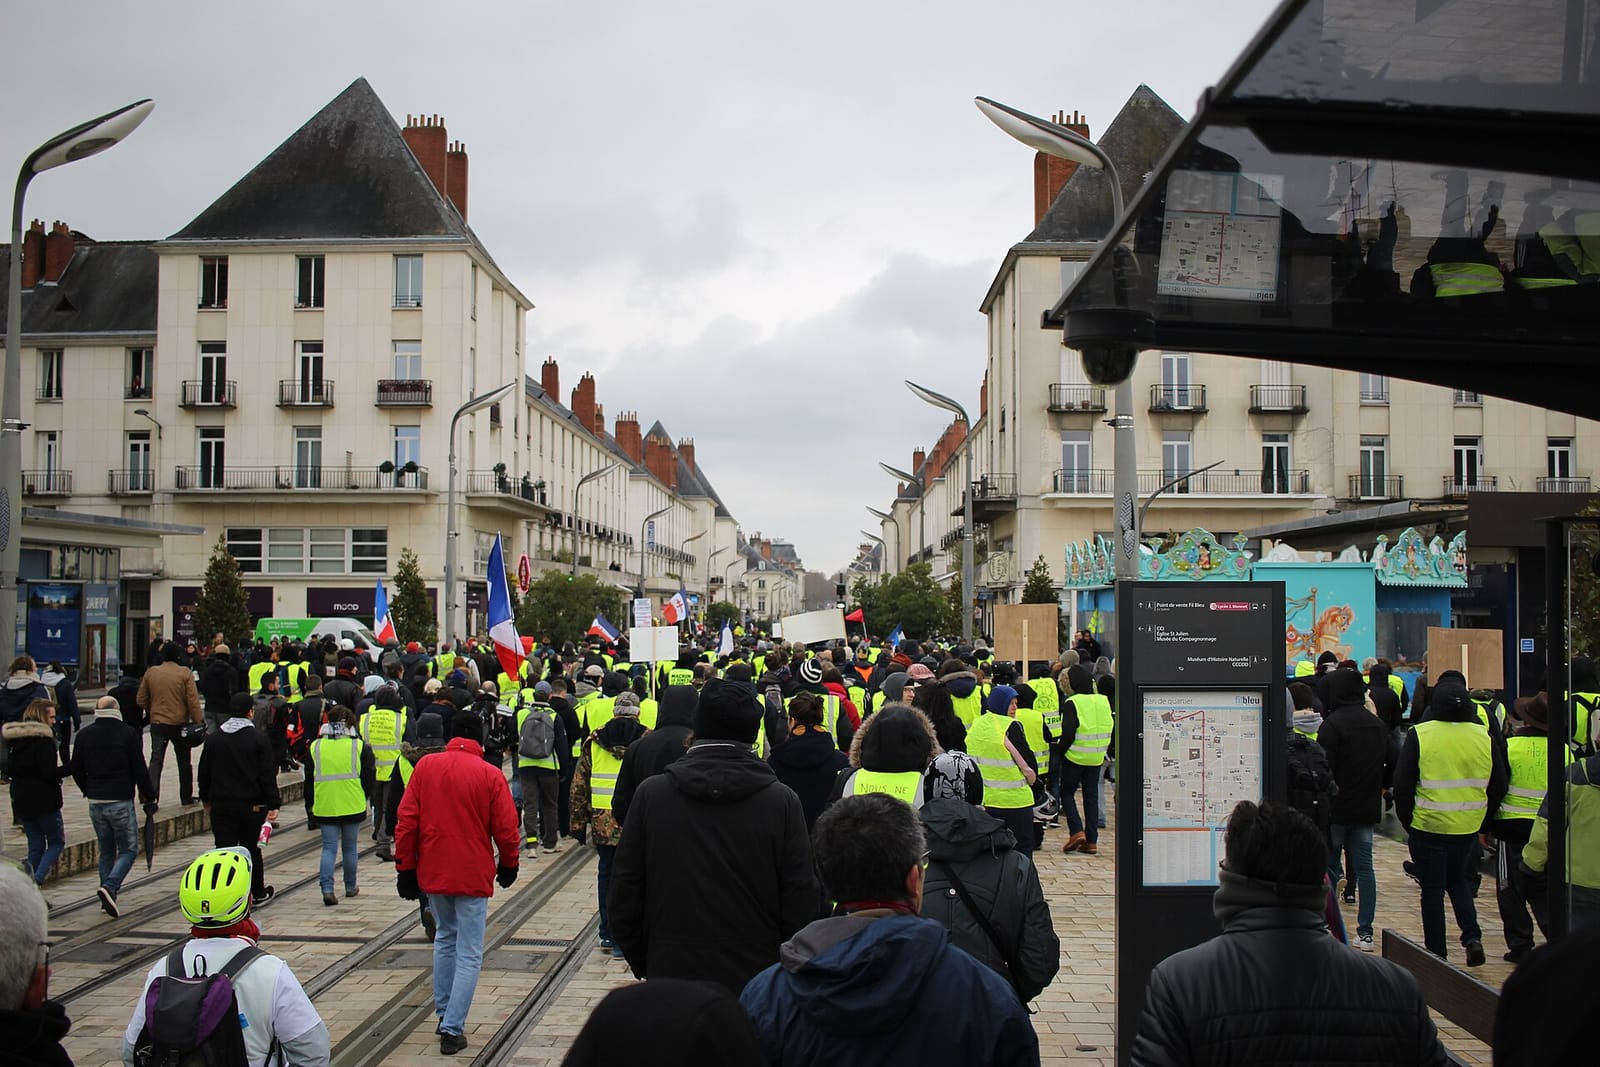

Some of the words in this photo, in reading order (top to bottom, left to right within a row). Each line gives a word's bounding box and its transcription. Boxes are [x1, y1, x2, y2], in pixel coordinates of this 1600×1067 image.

[1168, 697, 1193, 706] quartier
[1235, 695, 1260, 705] filbleu
[860, 783, 887, 793] NOUS
[894, 786, 908, 794] NE
